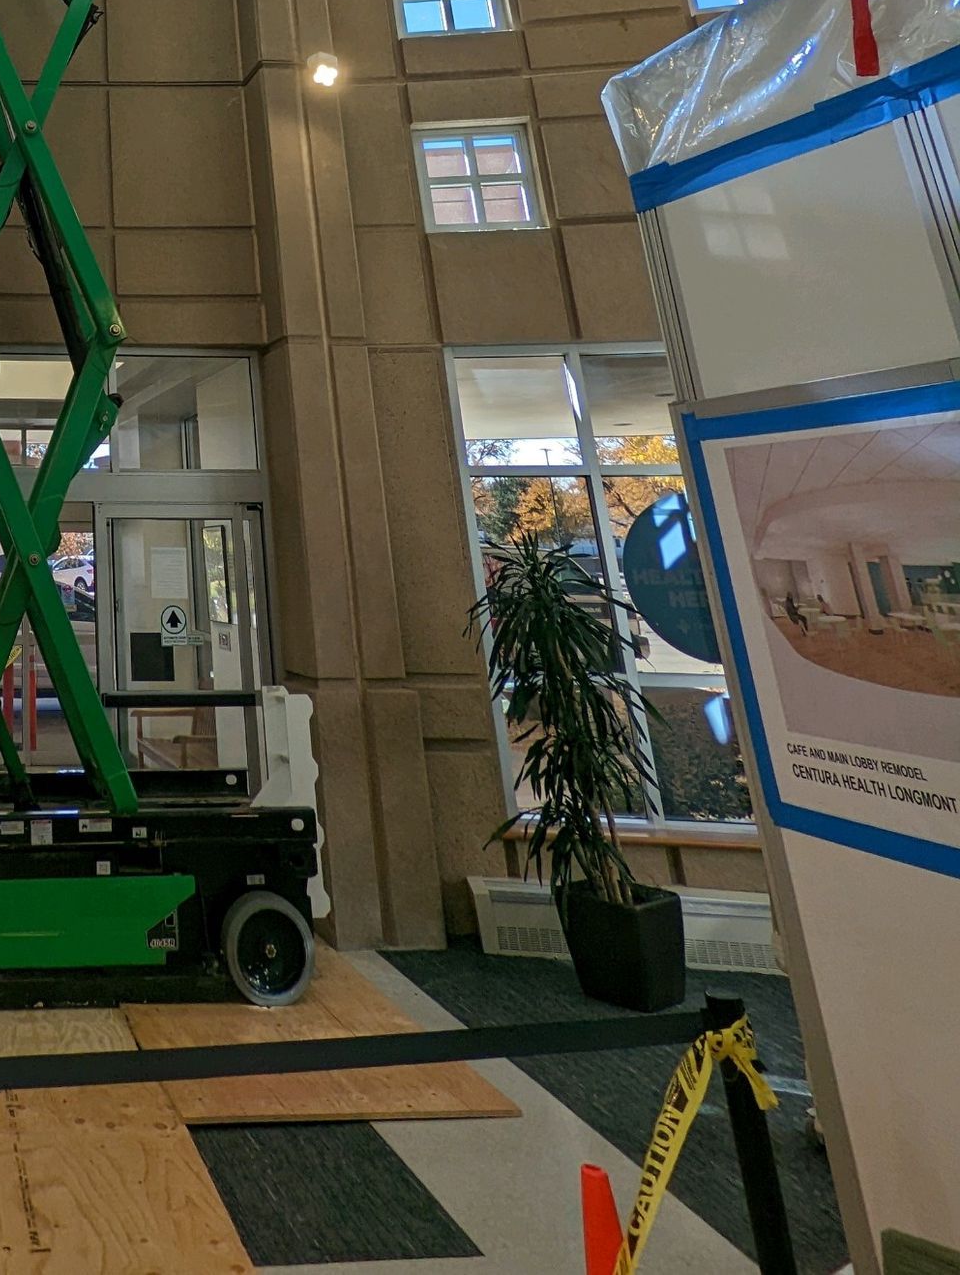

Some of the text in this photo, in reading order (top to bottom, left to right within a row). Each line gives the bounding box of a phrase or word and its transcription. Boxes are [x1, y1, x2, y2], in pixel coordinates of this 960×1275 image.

[787, 743, 928, 781] CAFE AND MAIN LOBBY REMODEL
[792, 763, 959, 813] CENTURA HEALTH LONGMONT
[628, 1103, 681, 1237] CAUTION
